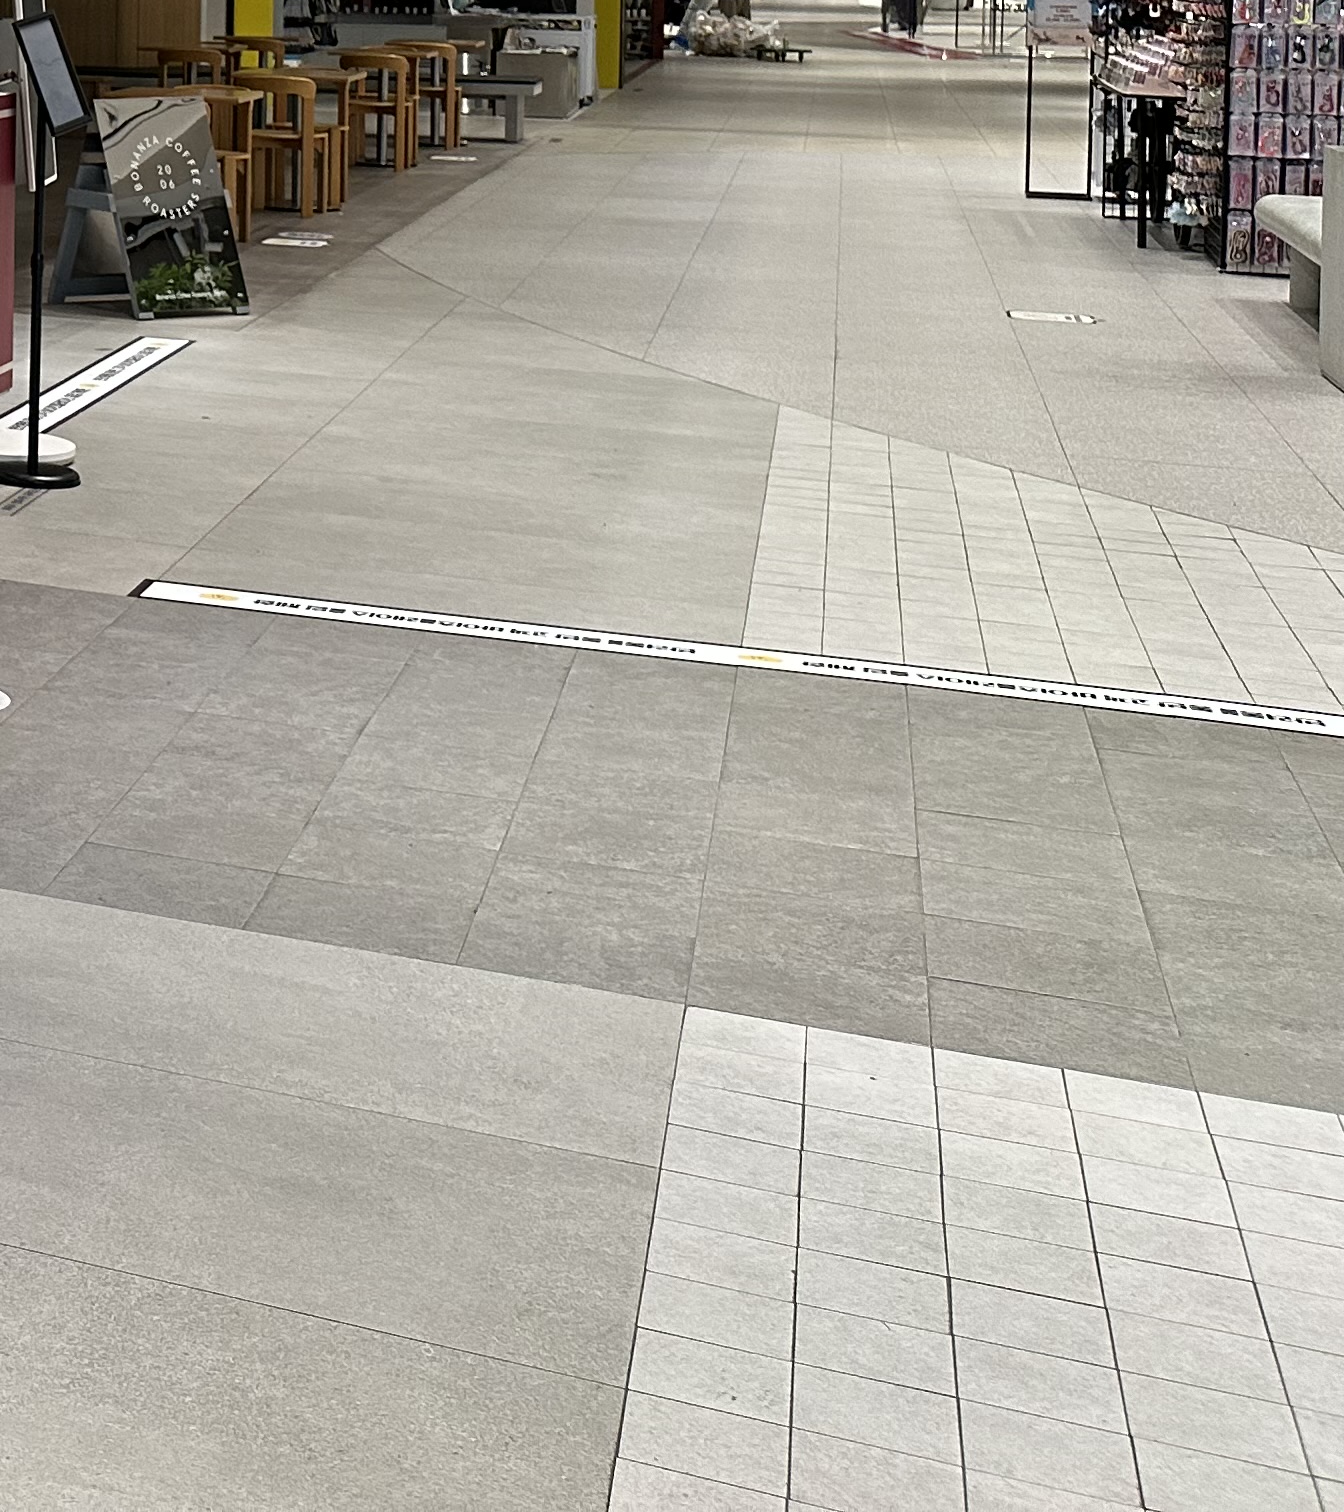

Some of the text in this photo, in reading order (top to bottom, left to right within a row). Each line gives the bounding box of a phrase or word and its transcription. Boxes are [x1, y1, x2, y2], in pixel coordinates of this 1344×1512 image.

[130, 135, 202, 220] BONANZA COFFEE ROASTERS
